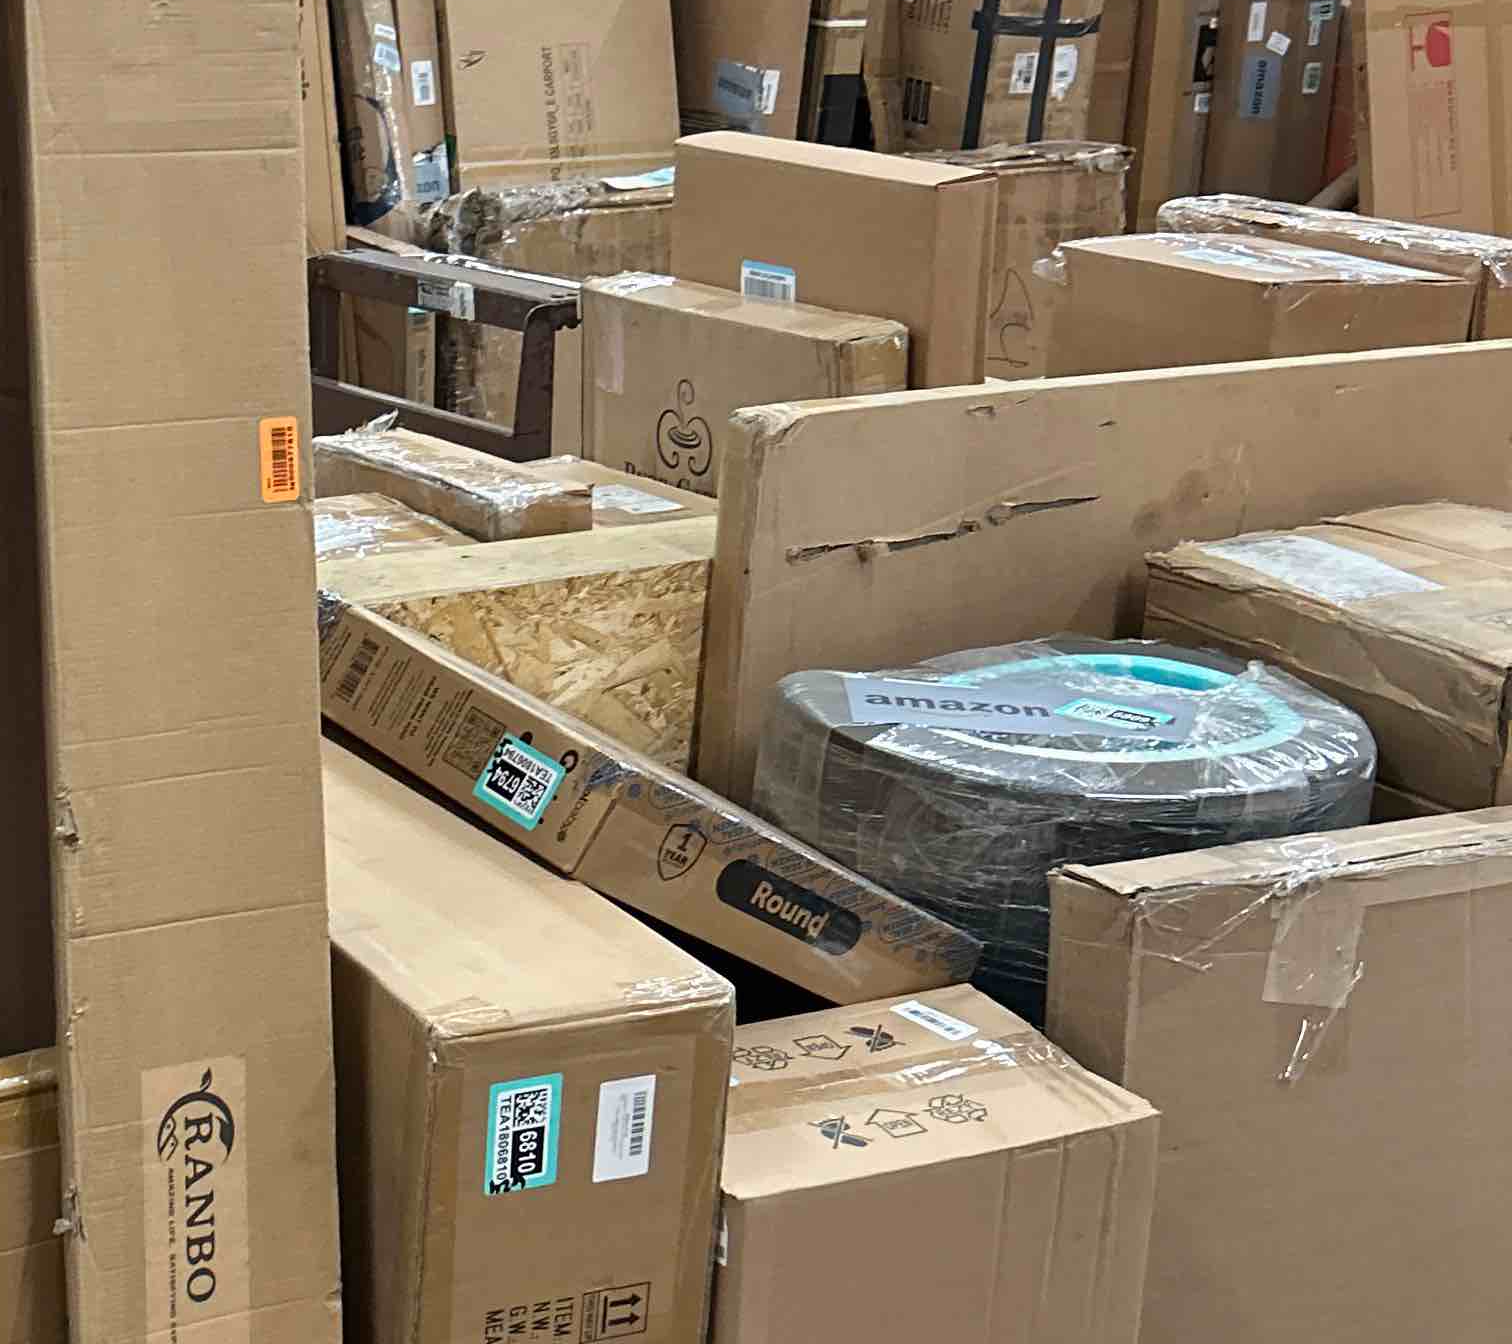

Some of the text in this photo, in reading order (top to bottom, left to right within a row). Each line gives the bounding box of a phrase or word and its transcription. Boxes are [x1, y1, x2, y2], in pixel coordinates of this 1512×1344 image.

[864, 690, 1049, 719] amazon
[491, 766, 520, 794] 6794
[749, 880, 830, 939] Round
[497, 1095, 512, 1180] TEA1806810
[518, 1130, 537, 1173] 6810
[183, 1112, 217, 1304] RANBO
